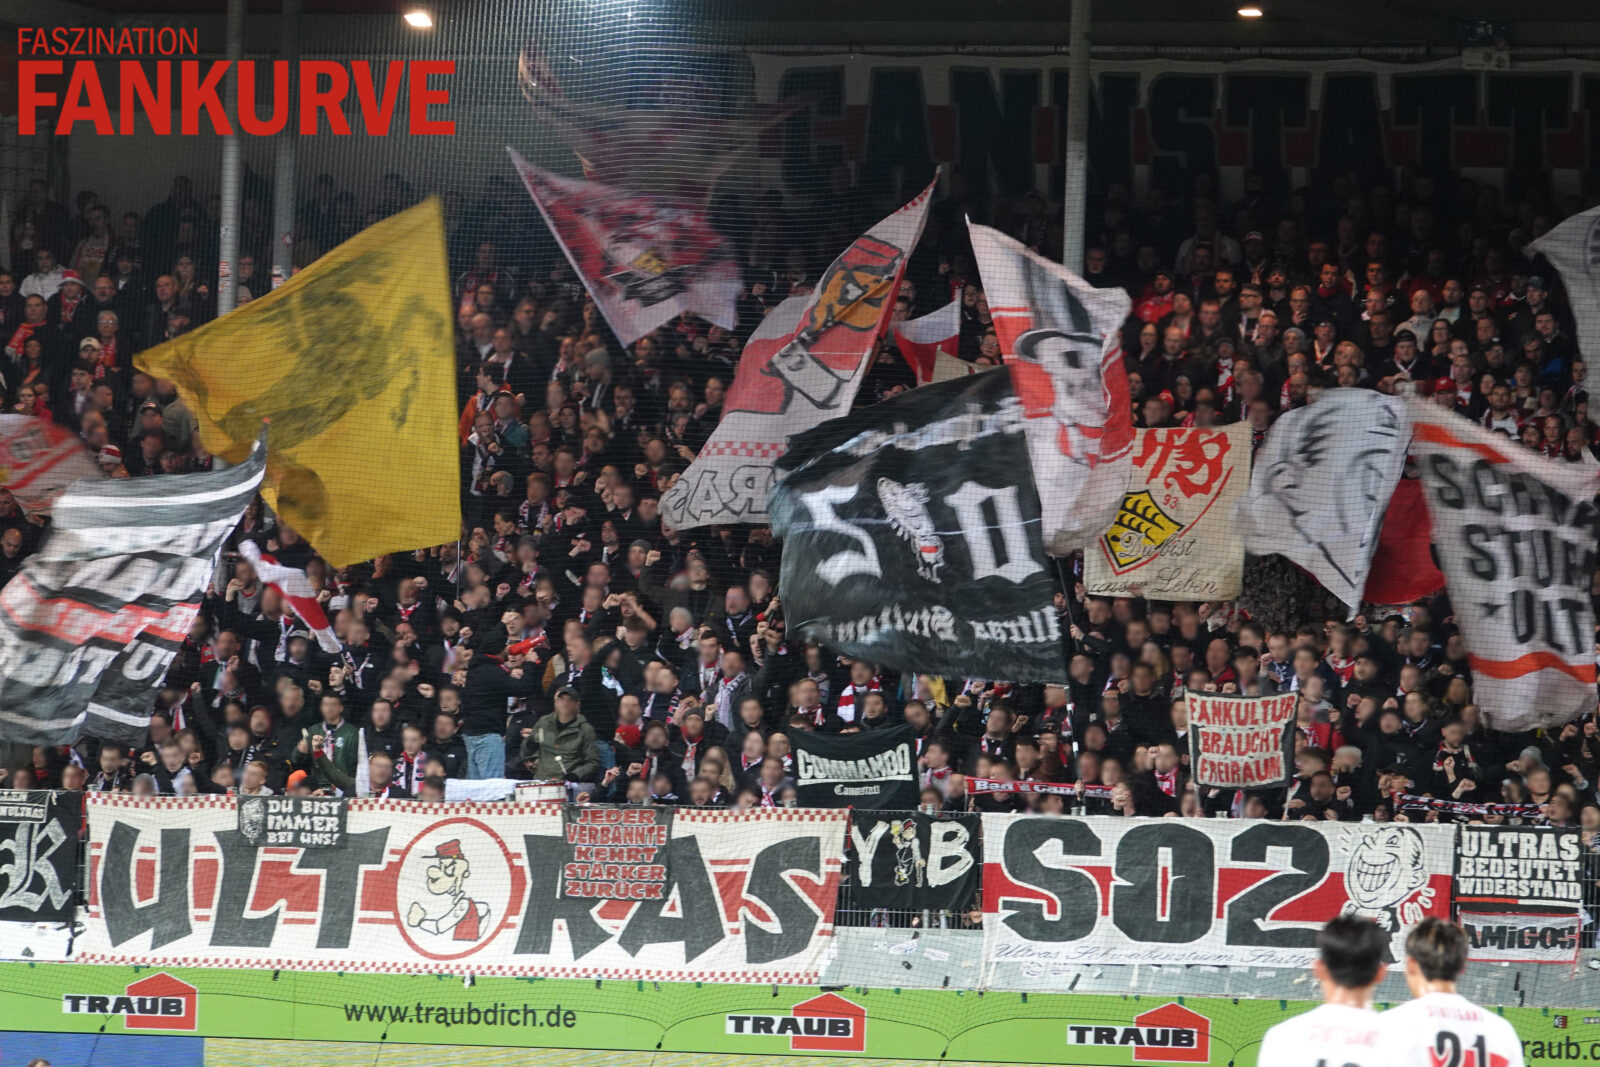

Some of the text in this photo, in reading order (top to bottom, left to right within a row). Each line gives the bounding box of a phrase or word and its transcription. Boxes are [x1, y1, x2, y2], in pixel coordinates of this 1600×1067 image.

[778, 66, 1600, 200] CANNSTATT
[1162, 494, 1179, 509] 93
[1189, 695, 1296, 726] FANKULTUR
[1201, 728, 1281, 756] BRAUCHT
[797, 743, 911, 779] COMMANDO
[1200, 755, 1281, 783] FREIRAUM
[267, 800, 341, 815] DU BIST
[577, 809, 656, 824] JEDER
[267, 815, 339, 832] IMMER
[566, 823, 667, 845] VERBANNTE
[267, 832, 340, 845] BEI UNS!
[1461, 831, 1580, 861] ULTRAS
[574, 846, 658, 862] KEHRT
[1460, 857, 1580, 881] BEDEUTET
[1459, 878, 1582, 899] WIDERSTAND
[65, 996, 183, 1015] TRAUB
[344, 1002, 576, 1028] www.traubdich.de
[728, 1015, 851, 1036] TRAUB
[1069, 1026, 1195, 1047] TRAUB
[1435, 1030, 1488, 1067] 21
